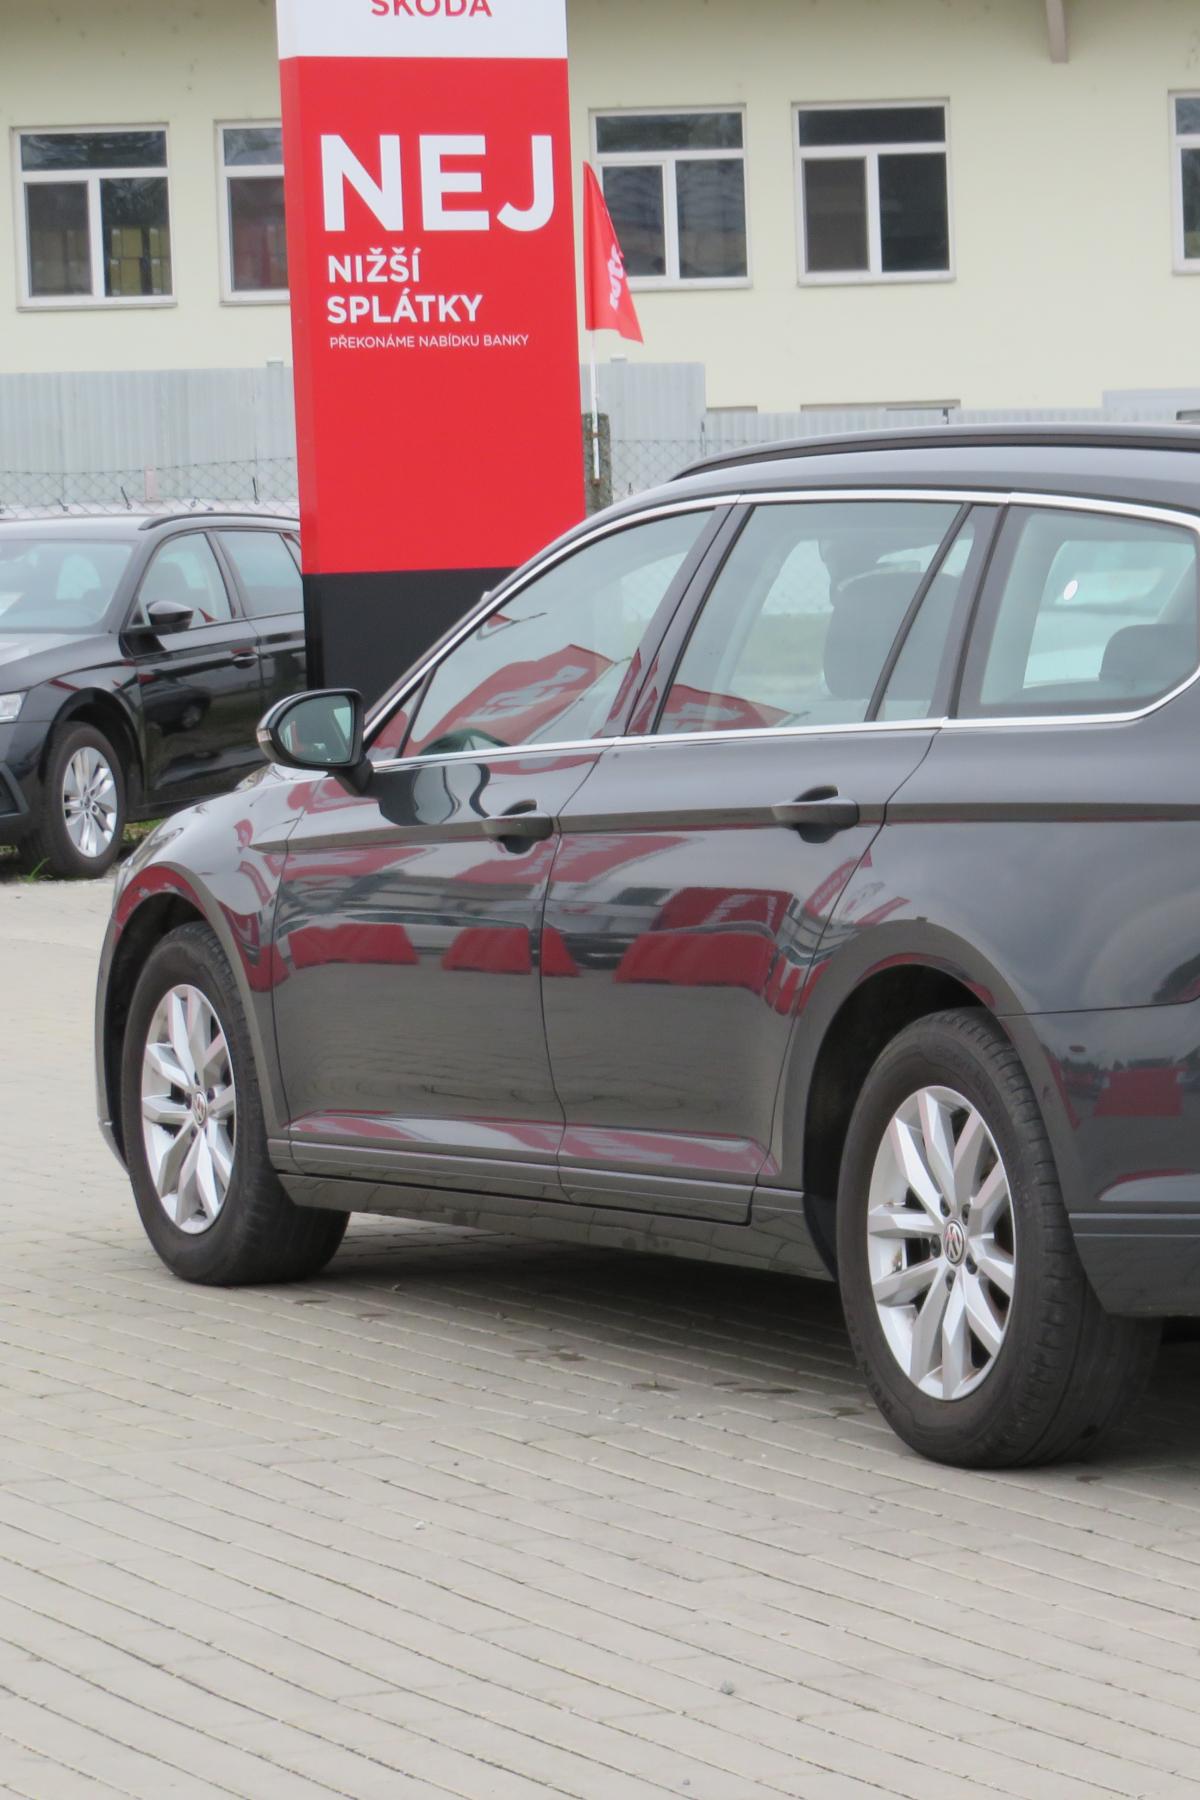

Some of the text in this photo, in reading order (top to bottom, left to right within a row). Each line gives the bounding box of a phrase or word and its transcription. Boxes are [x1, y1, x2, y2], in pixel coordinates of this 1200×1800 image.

[320, 134, 555, 232] NEJ
[327, 247, 422, 283] NIŽŠÍ
[326, 287, 484, 324] SPLÁTKY
[330, 333, 529, 349] PŘEKONÁME NABÍDKU BANKY
